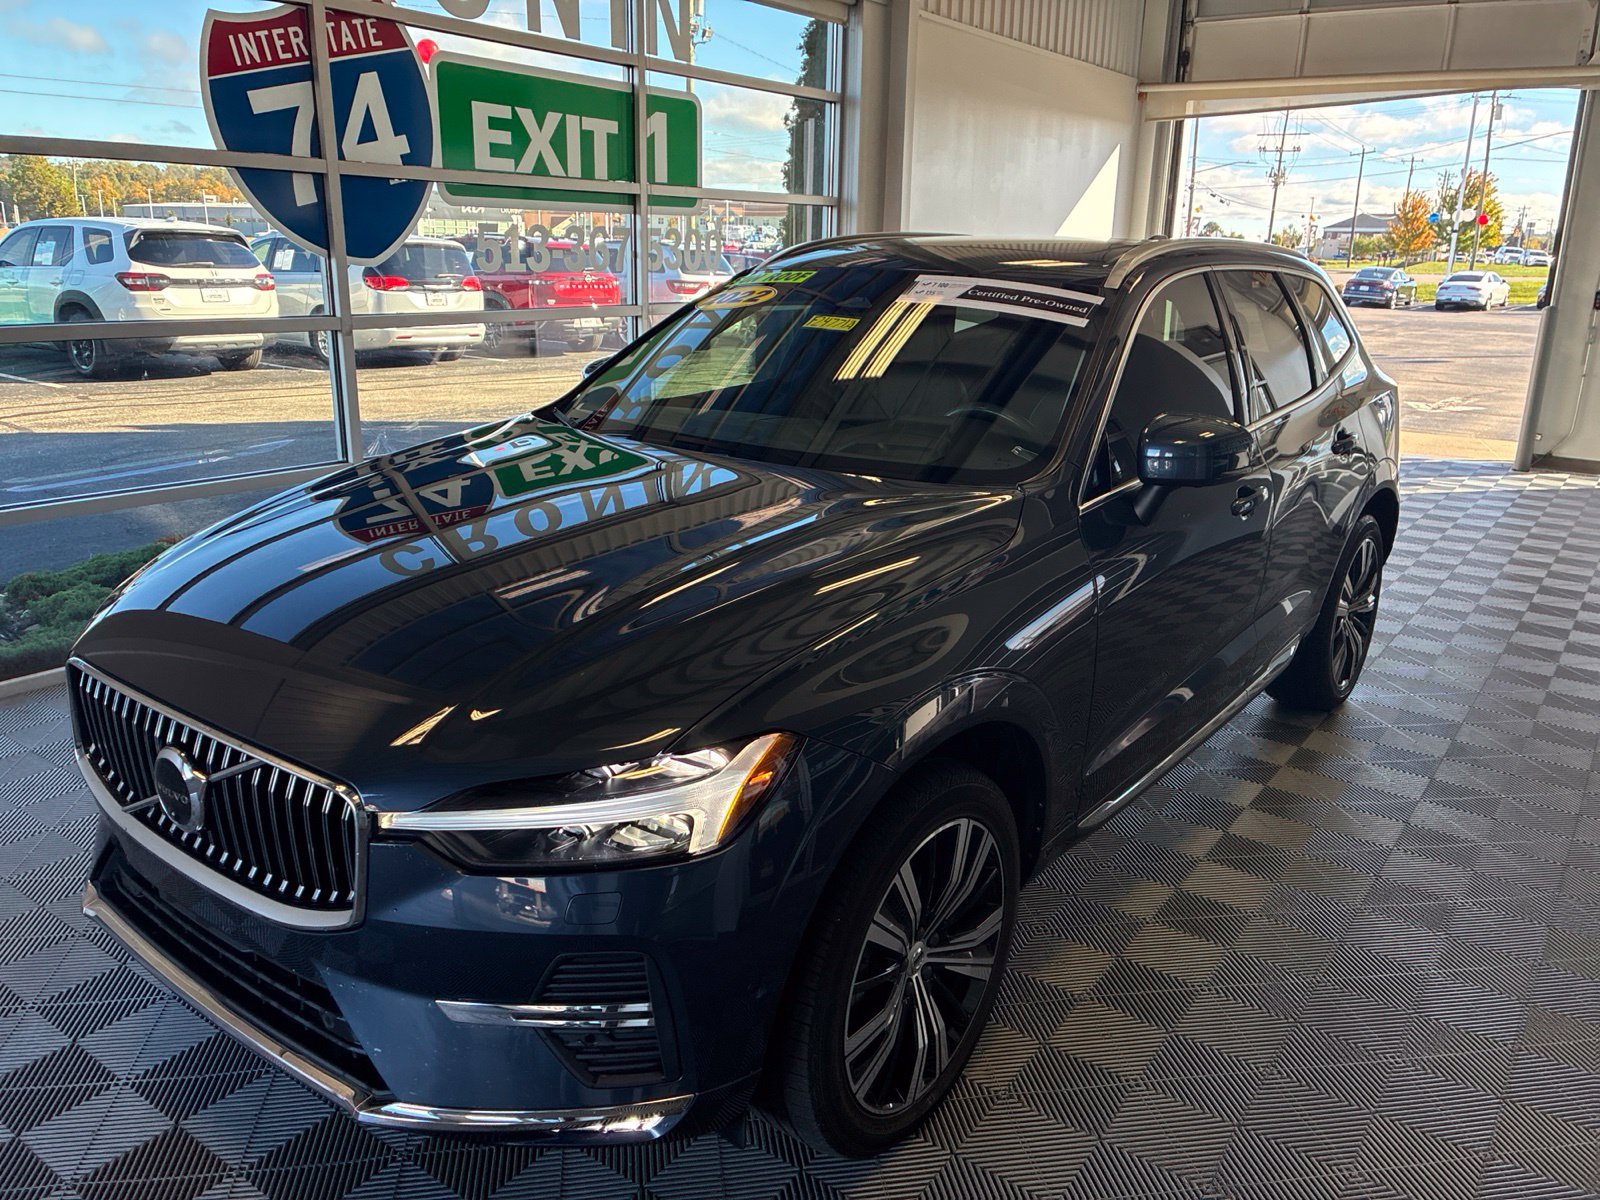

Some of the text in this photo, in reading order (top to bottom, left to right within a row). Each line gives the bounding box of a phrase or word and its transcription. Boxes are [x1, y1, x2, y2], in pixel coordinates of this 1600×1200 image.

[228, 18, 383, 67] INTERTATE
[246, 71, 411, 208] 74
[471, 100, 619, 181] EXIT
[476, 223, 722, 275] 513-3675300
[967, 288, 1088, 314] Certified Pre-Owned
